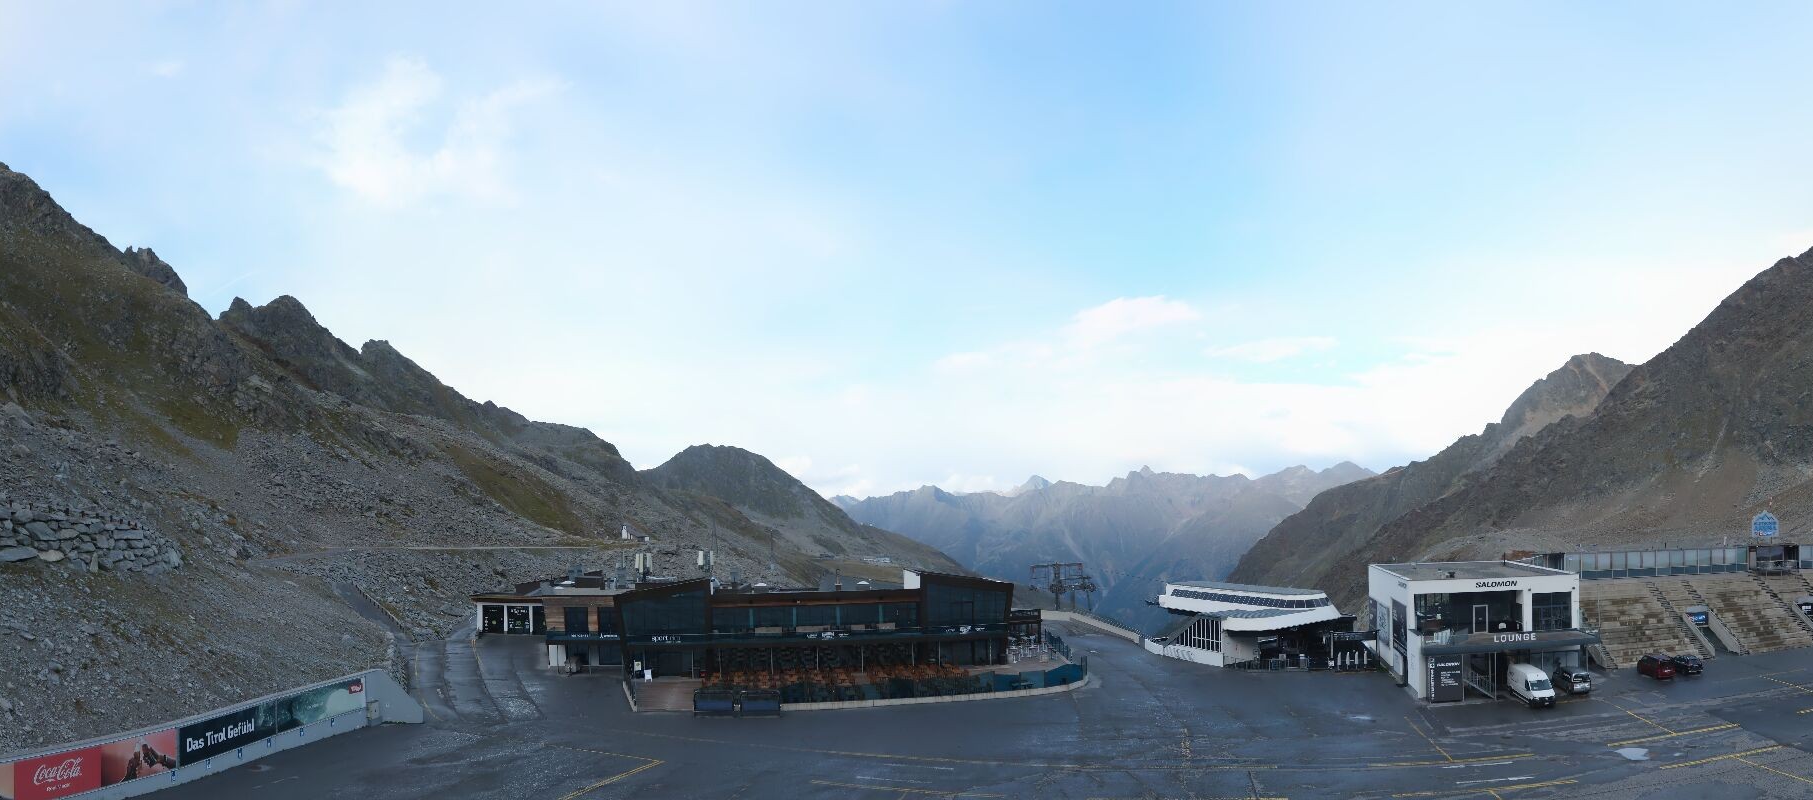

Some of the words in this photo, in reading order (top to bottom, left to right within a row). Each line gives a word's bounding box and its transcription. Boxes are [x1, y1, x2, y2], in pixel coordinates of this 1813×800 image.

[1475, 580, 1517, 588] SALOMON
[1494, 633, 1537, 643] LOUNGE
[186, 737, 205, 753] Das
[205, 727, 227, 747] Tirol
[227, 717, 255, 739] Gefühl
[34, 757, 83, 785] Coca-Cola
